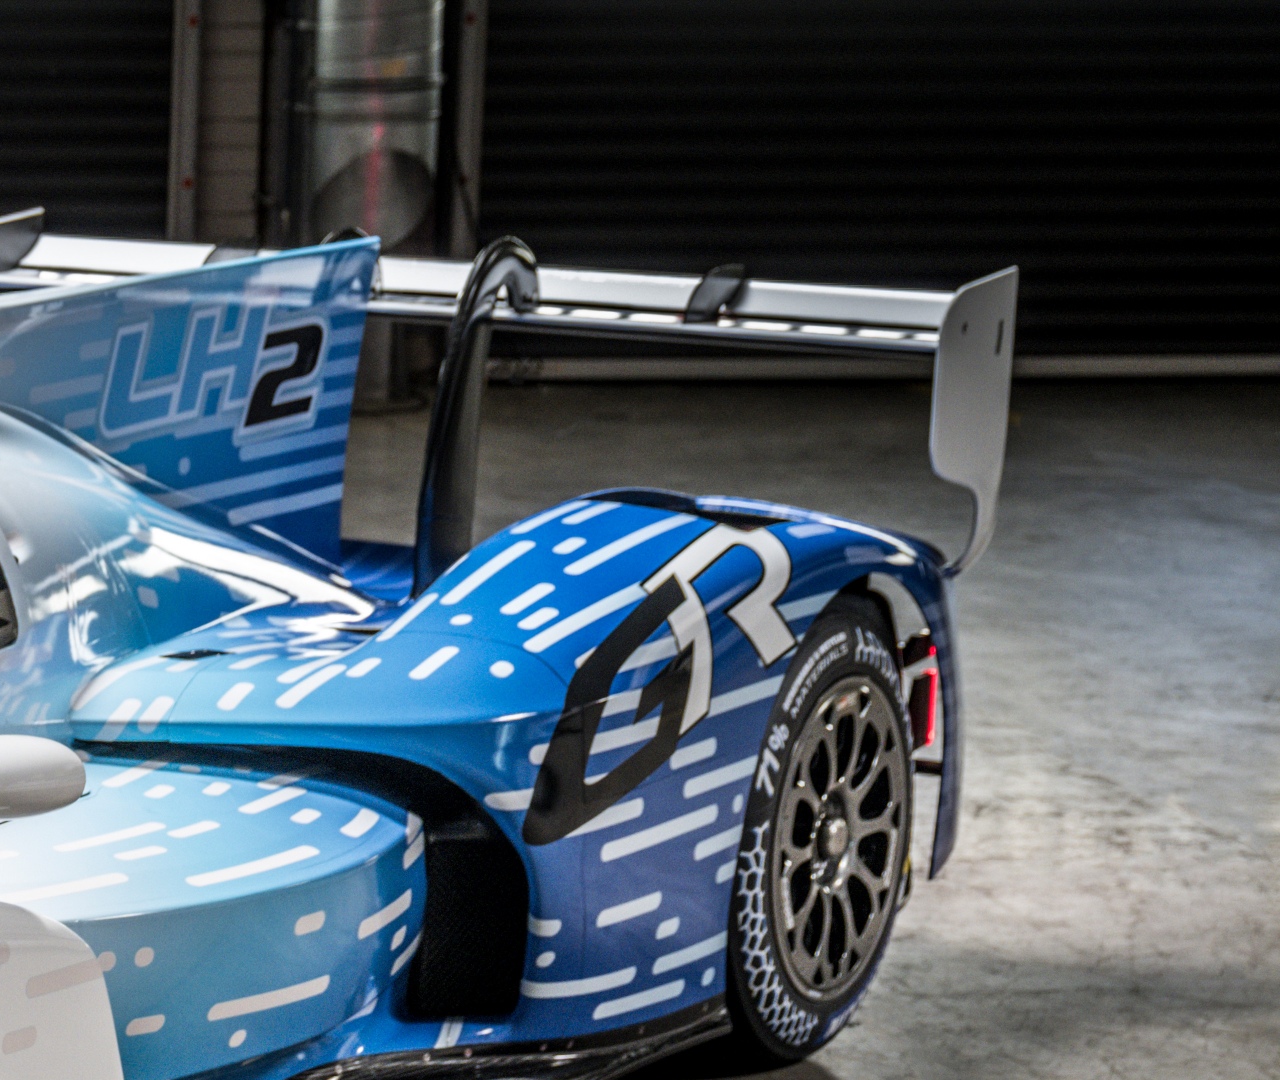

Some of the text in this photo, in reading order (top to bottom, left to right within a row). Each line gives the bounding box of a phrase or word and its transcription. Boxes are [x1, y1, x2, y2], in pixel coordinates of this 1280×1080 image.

[99, 300, 330, 446] LH2
[522, 524, 797, 845] GR
[755, 723, 789, 797] 71%
